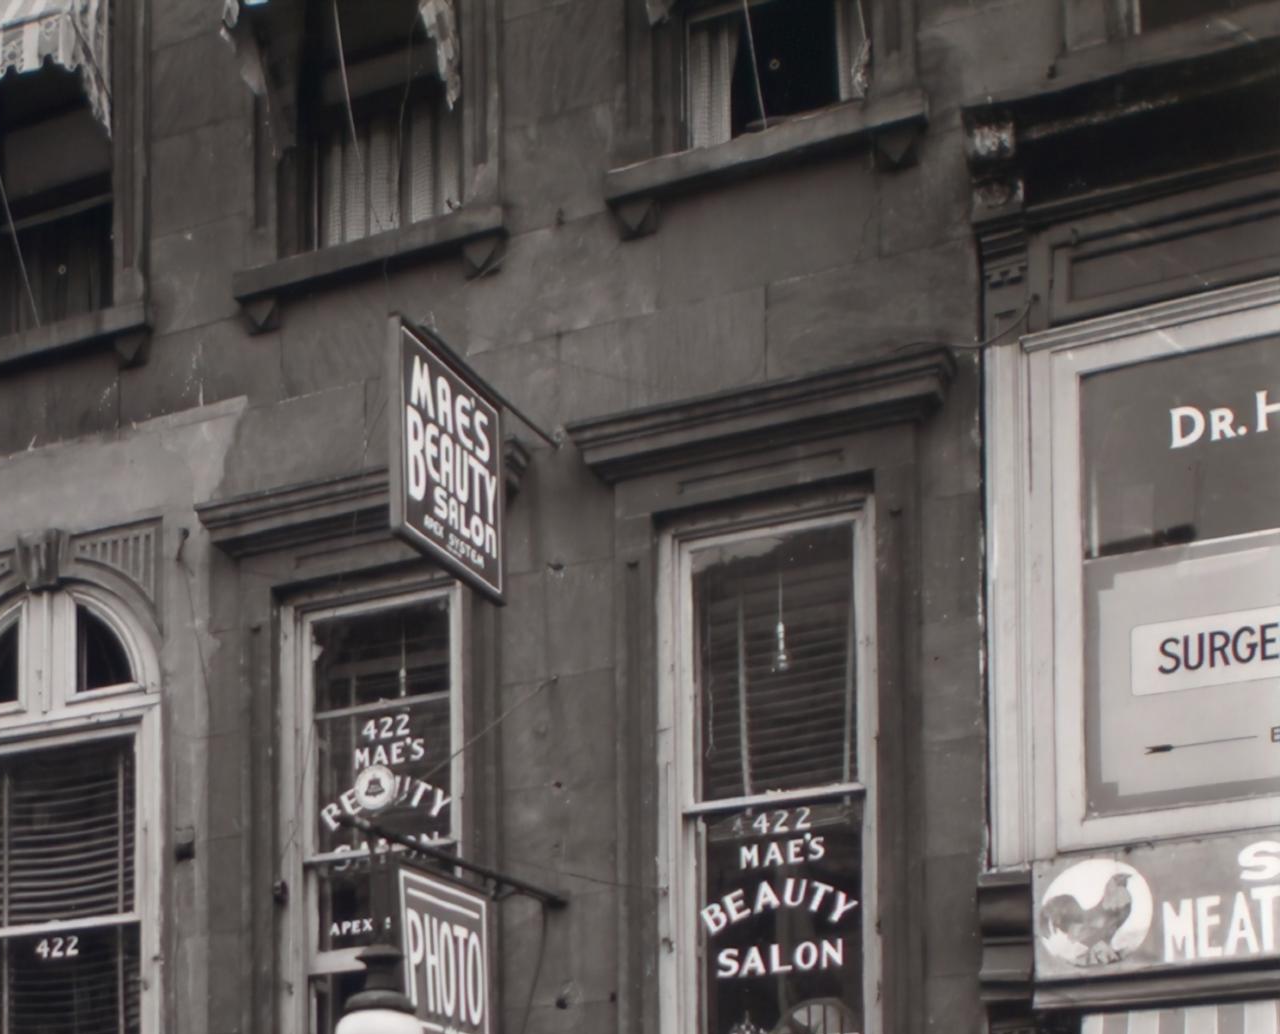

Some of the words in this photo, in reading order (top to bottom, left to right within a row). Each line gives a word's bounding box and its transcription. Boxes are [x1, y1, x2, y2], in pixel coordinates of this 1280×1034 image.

[410, 354, 490, 463] MAE'S
[1169, 405, 1248, 449] DR.
[406, 404, 497, 525] BEAUTY
[433, 485, 497, 559] SALON
[448, 532, 485, 568] SYSTEM
[361, 714, 411, 740] 422
[353, 737, 425, 770] MAE'S
[321, 775, 452, 831] BEUTY
[752, 806, 812, 834] 422
[740, 832, 825, 870] MAE'S
[329, 918, 373, 936] APEX
[700, 878, 859, 936] BEAUTY
[35, 936, 80, 959] 422
[406, 907, 483, 1026] PHOTO
[717, 938, 843, 978] SALON
